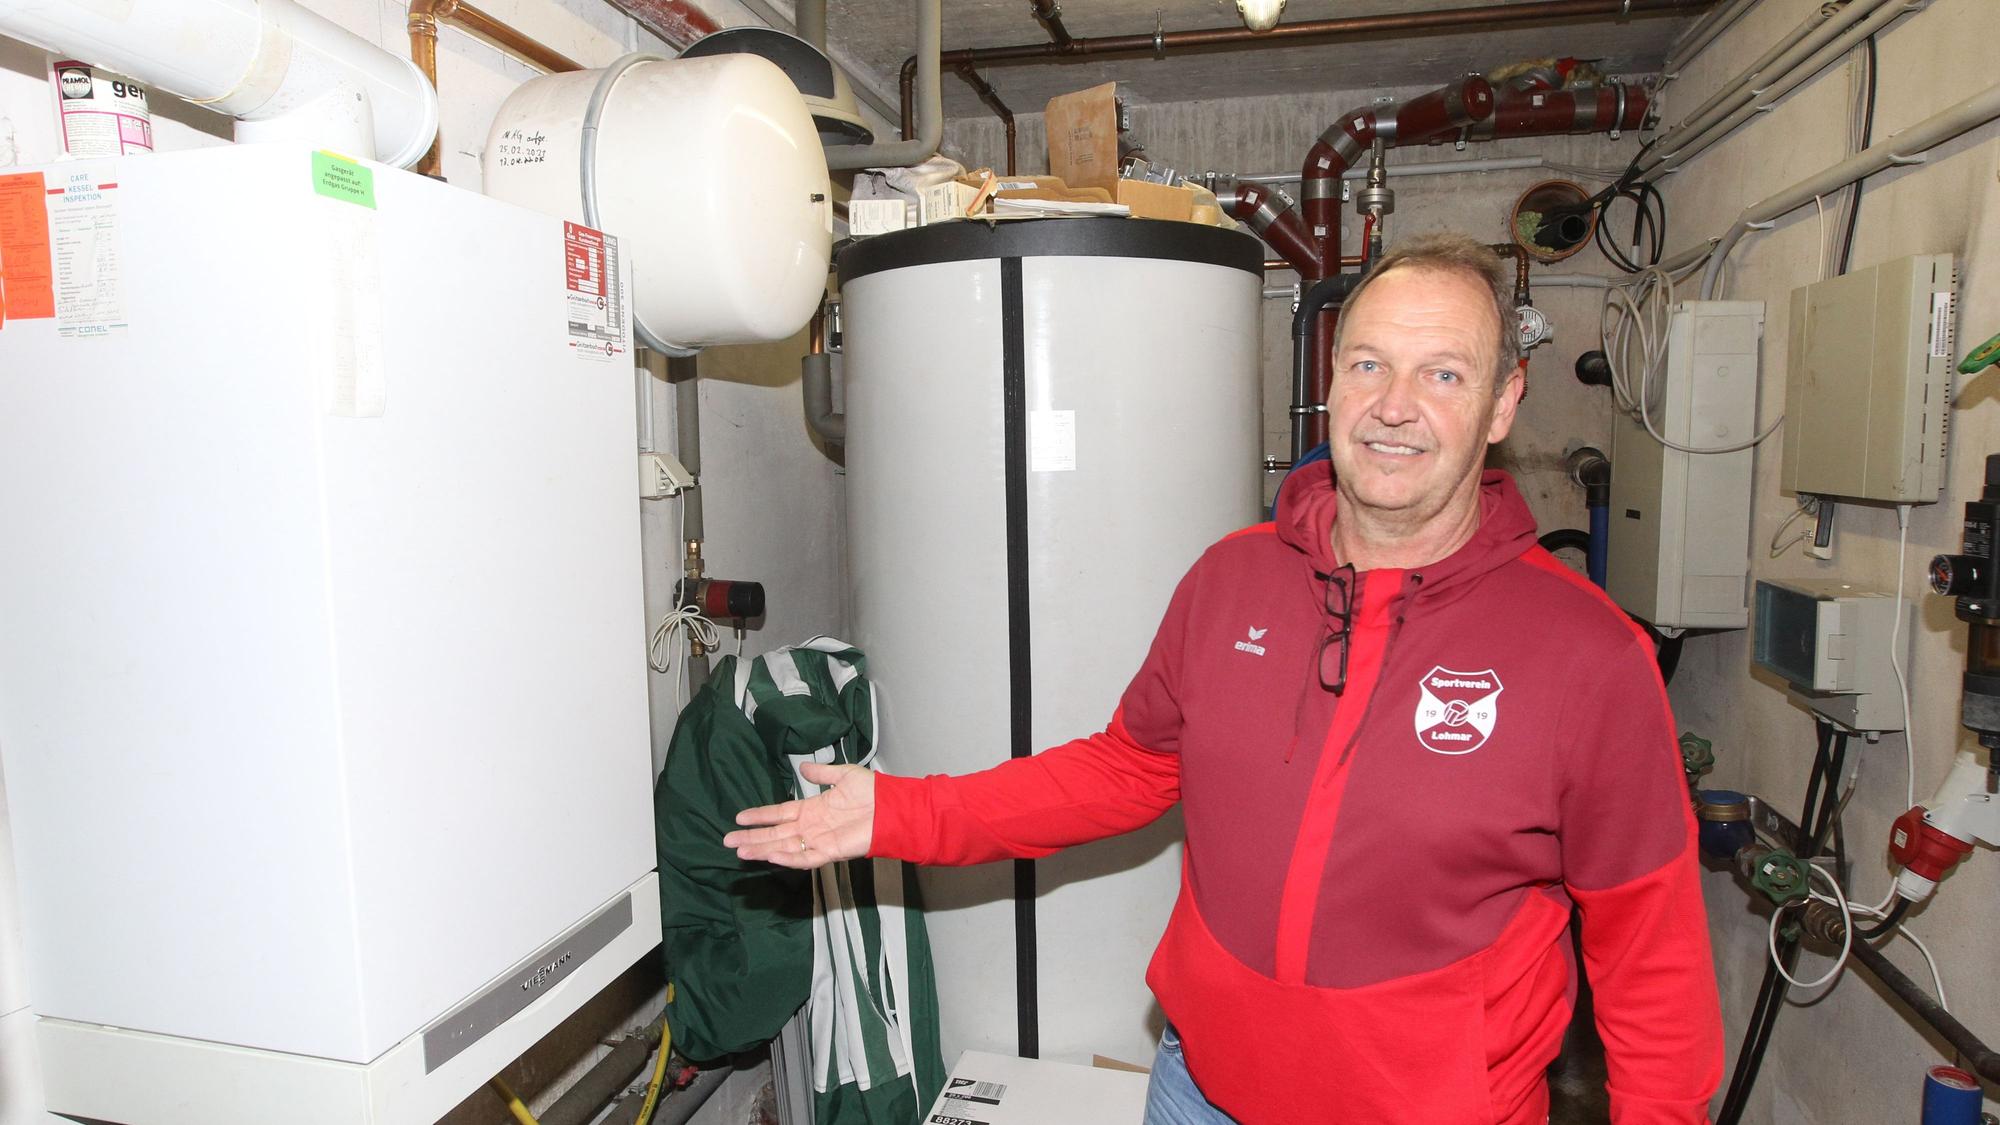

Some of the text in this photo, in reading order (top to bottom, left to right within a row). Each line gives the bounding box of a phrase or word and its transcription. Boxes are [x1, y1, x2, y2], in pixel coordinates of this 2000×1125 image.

[331, 164, 354, 176] Gasgerät
[70, 174, 88, 182] CARE
[324, 171, 351, 184] angepasst
[68, 184, 93, 193] KESSEL
[322, 178, 340, 189] Erdgas
[340, 183, 360, 195] Gruppe
[63, 193, 102, 203] INSPEKTION
[566, 232, 576, 241] Gas
[78, 325, 108, 334] CONEL
[1234, 640, 1266, 657] erima
[1430, 677, 1491, 690] Sportverein
[1426, 709, 1488, 720] 19 19
[1431, 730, 1473, 742] Lohmar
[519, 950, 572, 992] VIESSMANN
